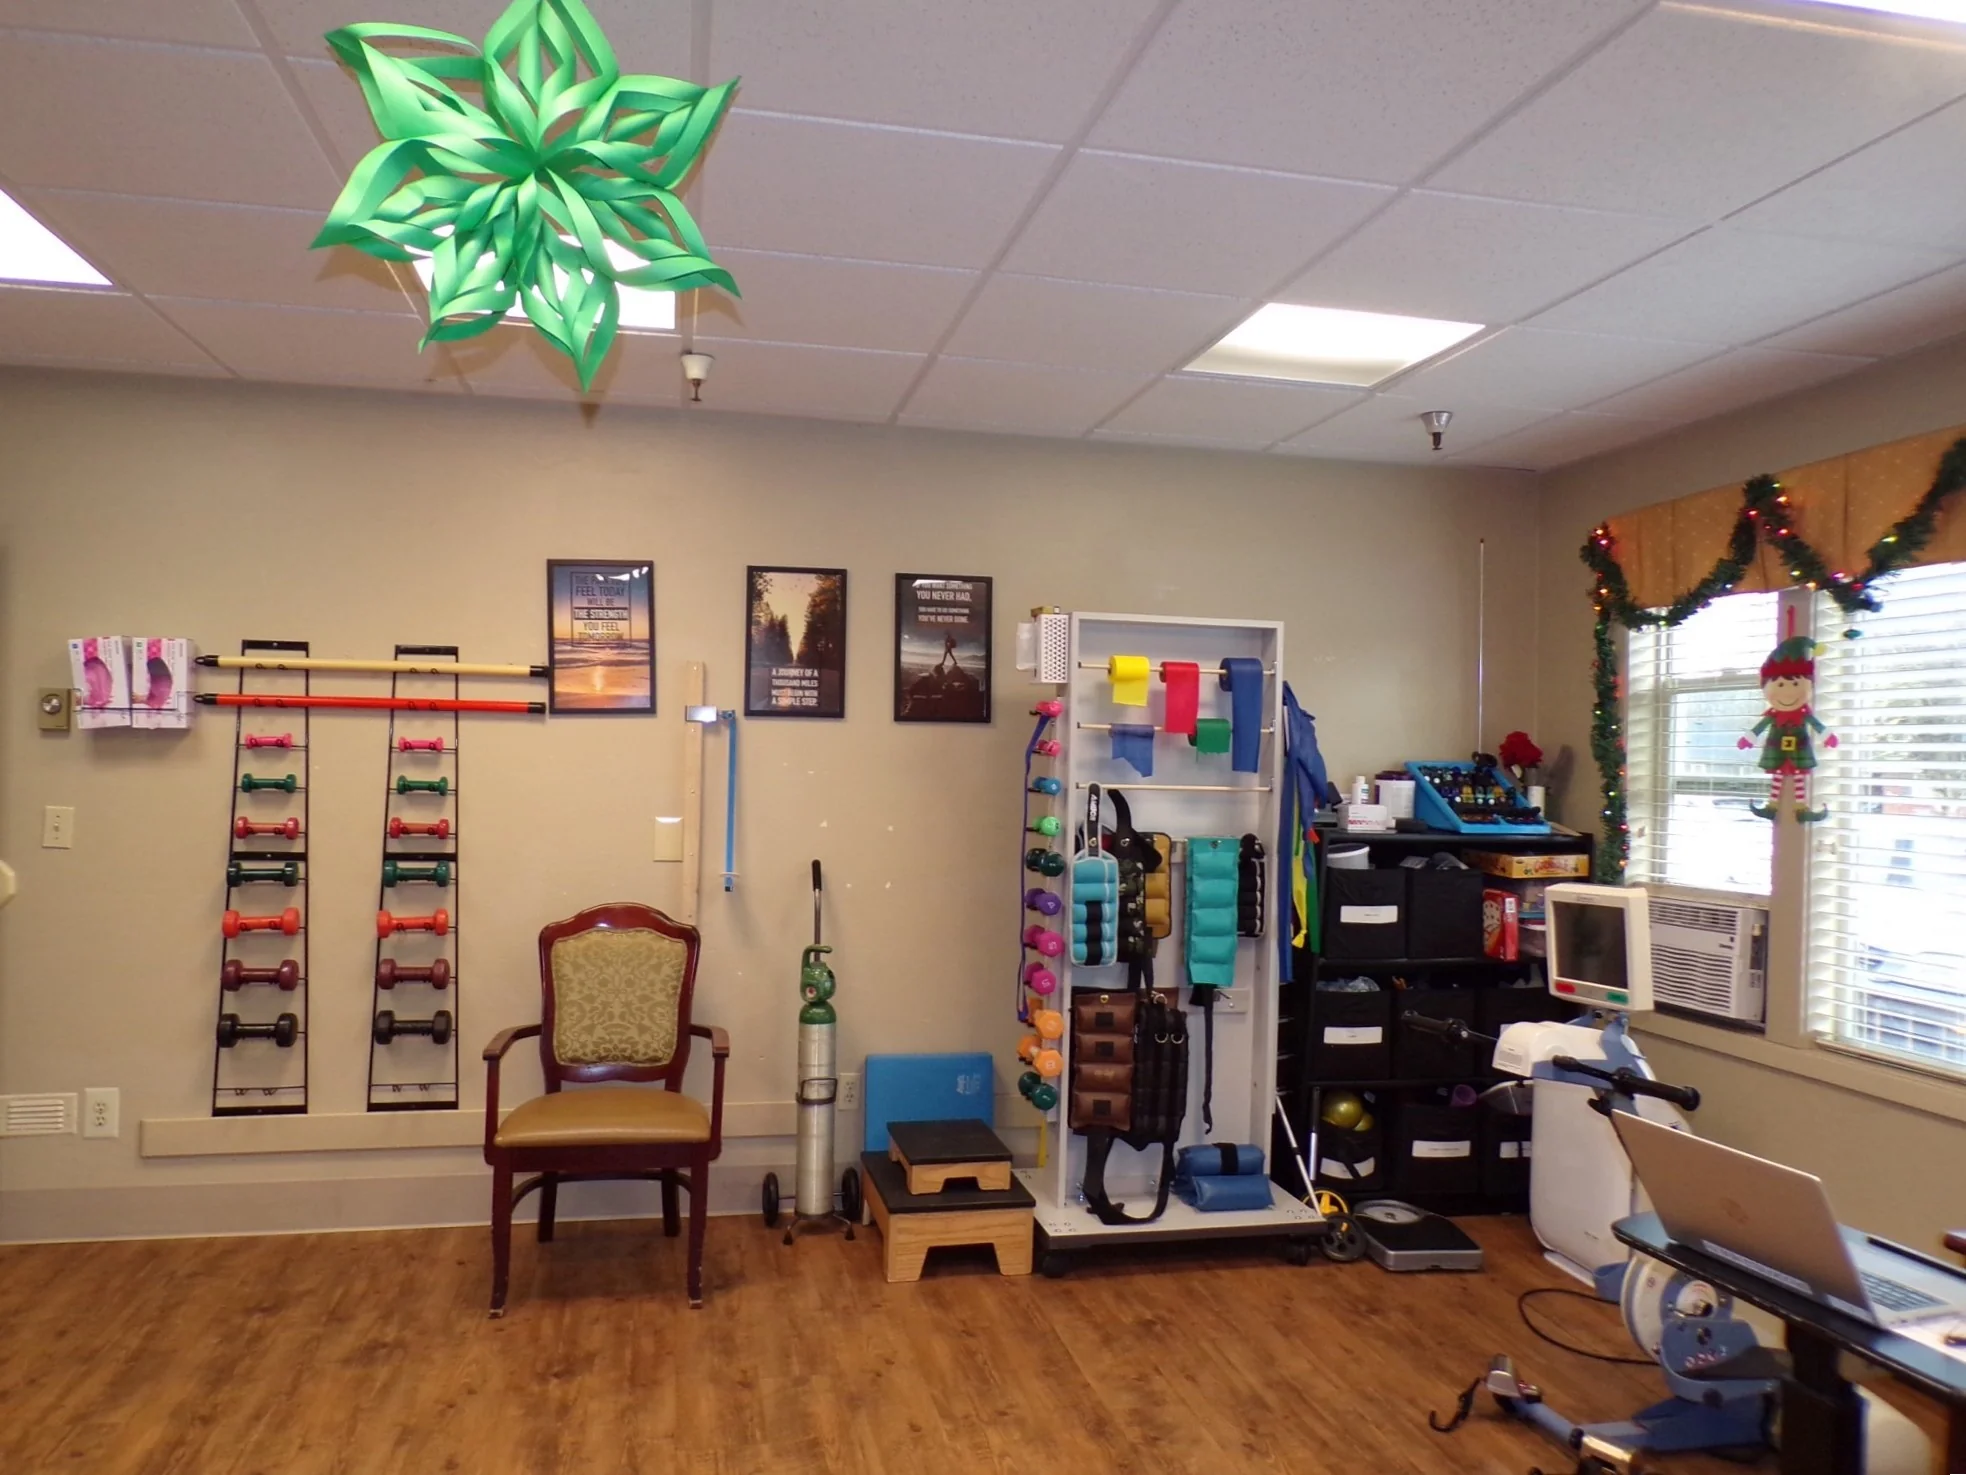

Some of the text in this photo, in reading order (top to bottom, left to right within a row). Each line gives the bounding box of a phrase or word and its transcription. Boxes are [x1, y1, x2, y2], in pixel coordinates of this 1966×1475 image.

[575, 586, 625, 597] FEEL TODAY
[916, 590, 930, 601] YOU
[931, 590, 955, 601] NEVER
[583, 622, 620, 631] YOU FEEL
[771, 668, 777, 678] A
[813, 668, 819, 678] A
